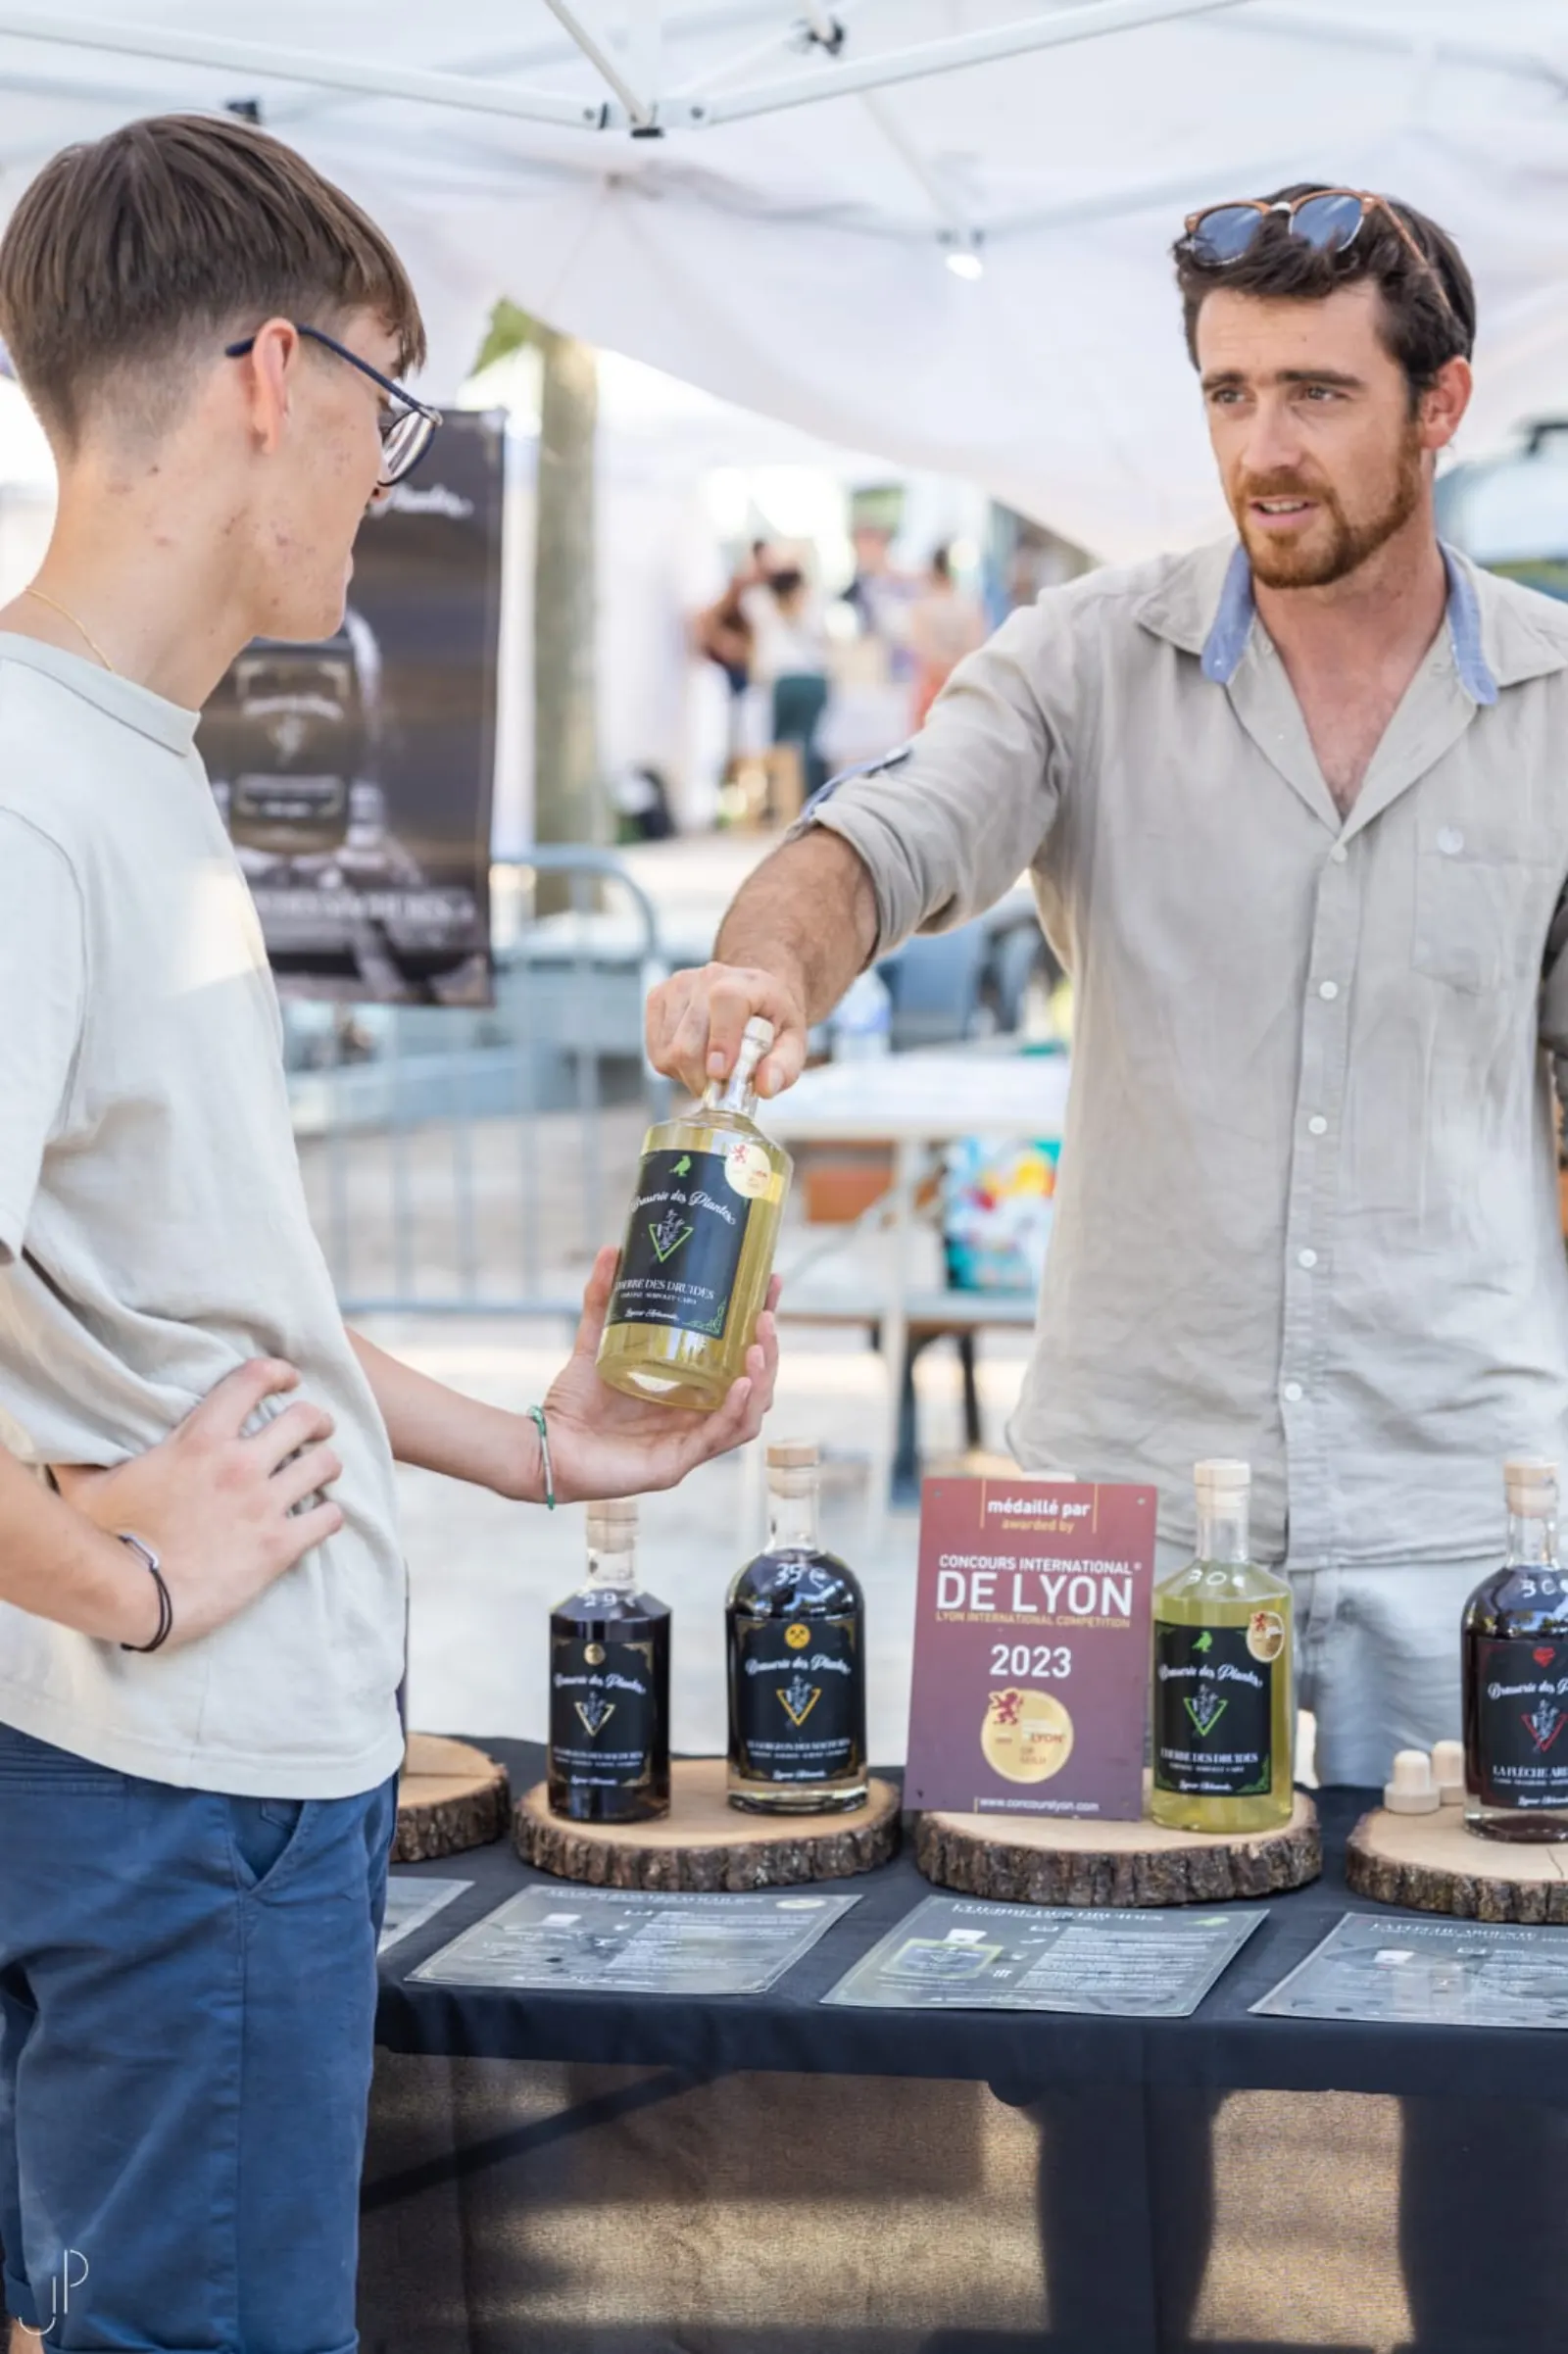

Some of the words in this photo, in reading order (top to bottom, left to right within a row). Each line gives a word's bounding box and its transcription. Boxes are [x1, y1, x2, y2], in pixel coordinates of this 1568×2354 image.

[688, 1191, 736, 1225] Plantes
[988, 1496, 1059, 1515] médaillé
[1061, 1503, 1092, 1519] par
[1002, 1519, 1057, 1532] awarded
[1058, 1521, 1075, 1535] by
[939, 1554, 1016, 1570] CONCOURS
[936, 1570, 998, 1611] DE
[1012, 1573, 1133, 1616] LYON
[936, 1611, 965, 1623] LYON
[966, 1612, 1054, 1627] INTERNATIONAL
[1055, 1615, 1131, 1629] COMPETITION
[990, 1644, 1072, 1678] 2023
